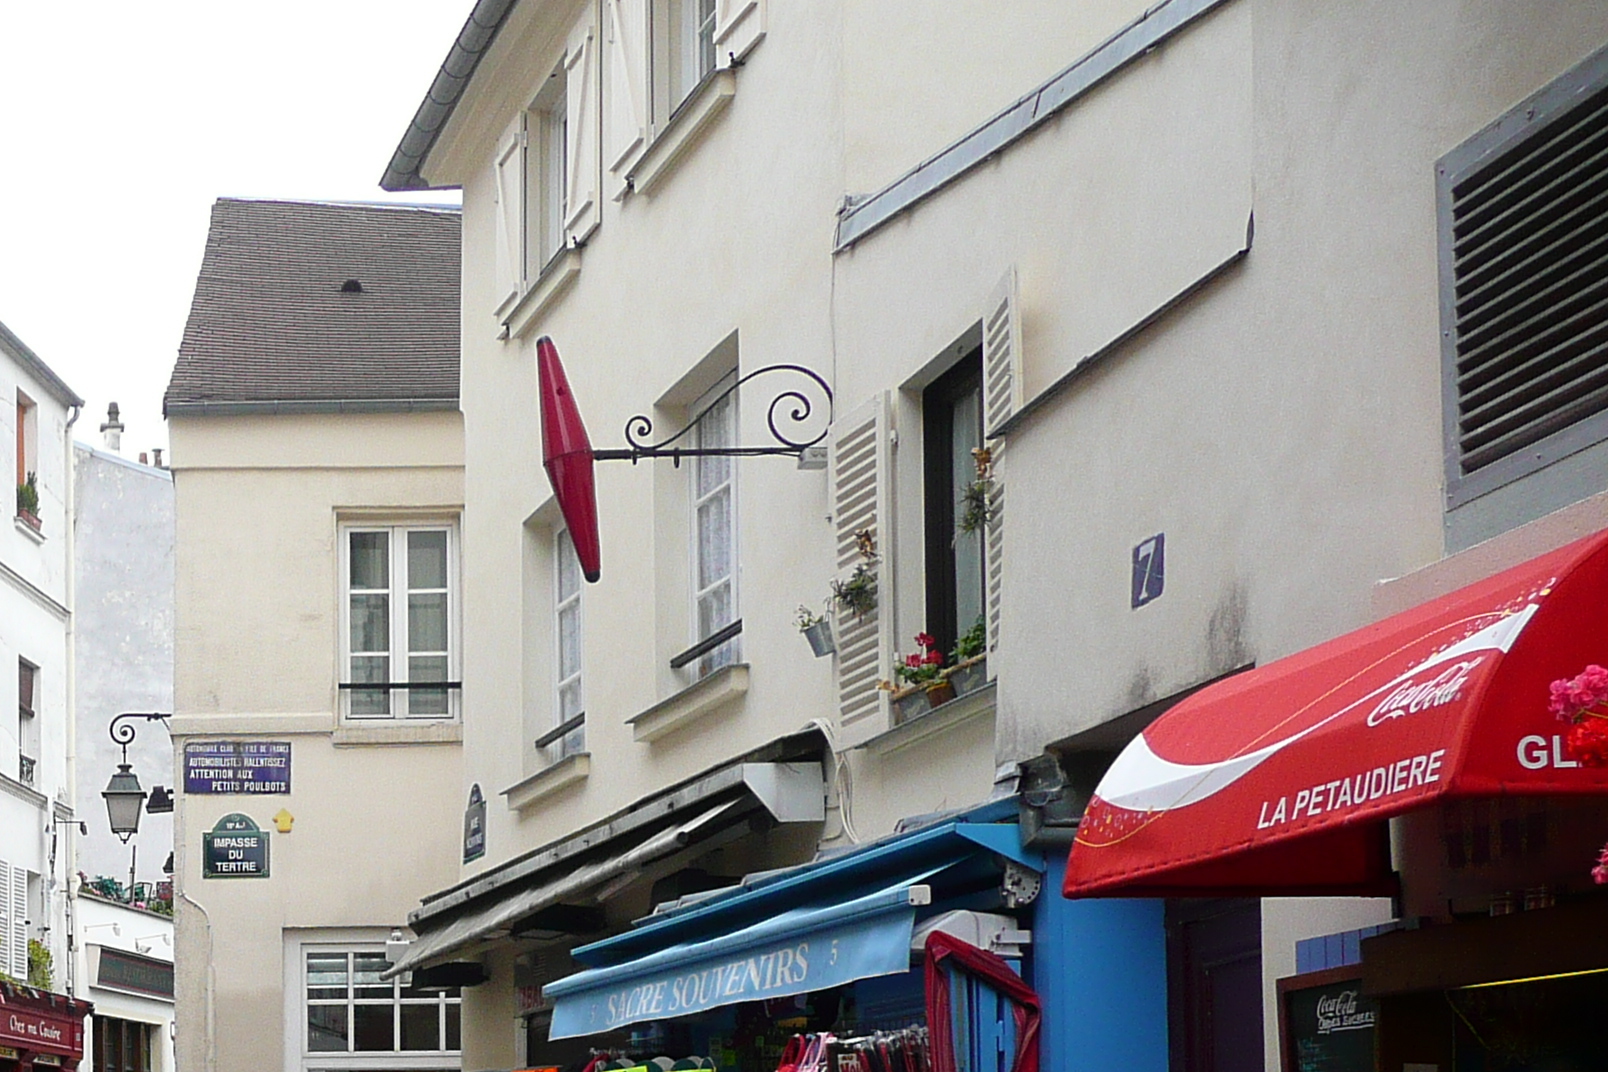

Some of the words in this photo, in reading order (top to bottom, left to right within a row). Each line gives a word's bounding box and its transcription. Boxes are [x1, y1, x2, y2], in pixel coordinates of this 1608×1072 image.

[1138, 540, 1155, 601] 7
[190, 769, 233, 779] ATTENTION
[237, 769, 253, 779] AUX
[212, 781, 240, 791] PETITS
[244, 781, 286, 791] POULBOTS
[1257, 797, 1286, 830] LA
[1291, 749, 1445, 820] PETAUDIERE
[214, 837, 258, 848] IMPASSE
[228, 849, 243, 860] DU
[215, 861, 257, 872] TERTRE
[606, 981, 667, 1026] SACRE
[668, 943, 810, 1011] SOUVENIRS
[829, 939, 839, 966] 5
